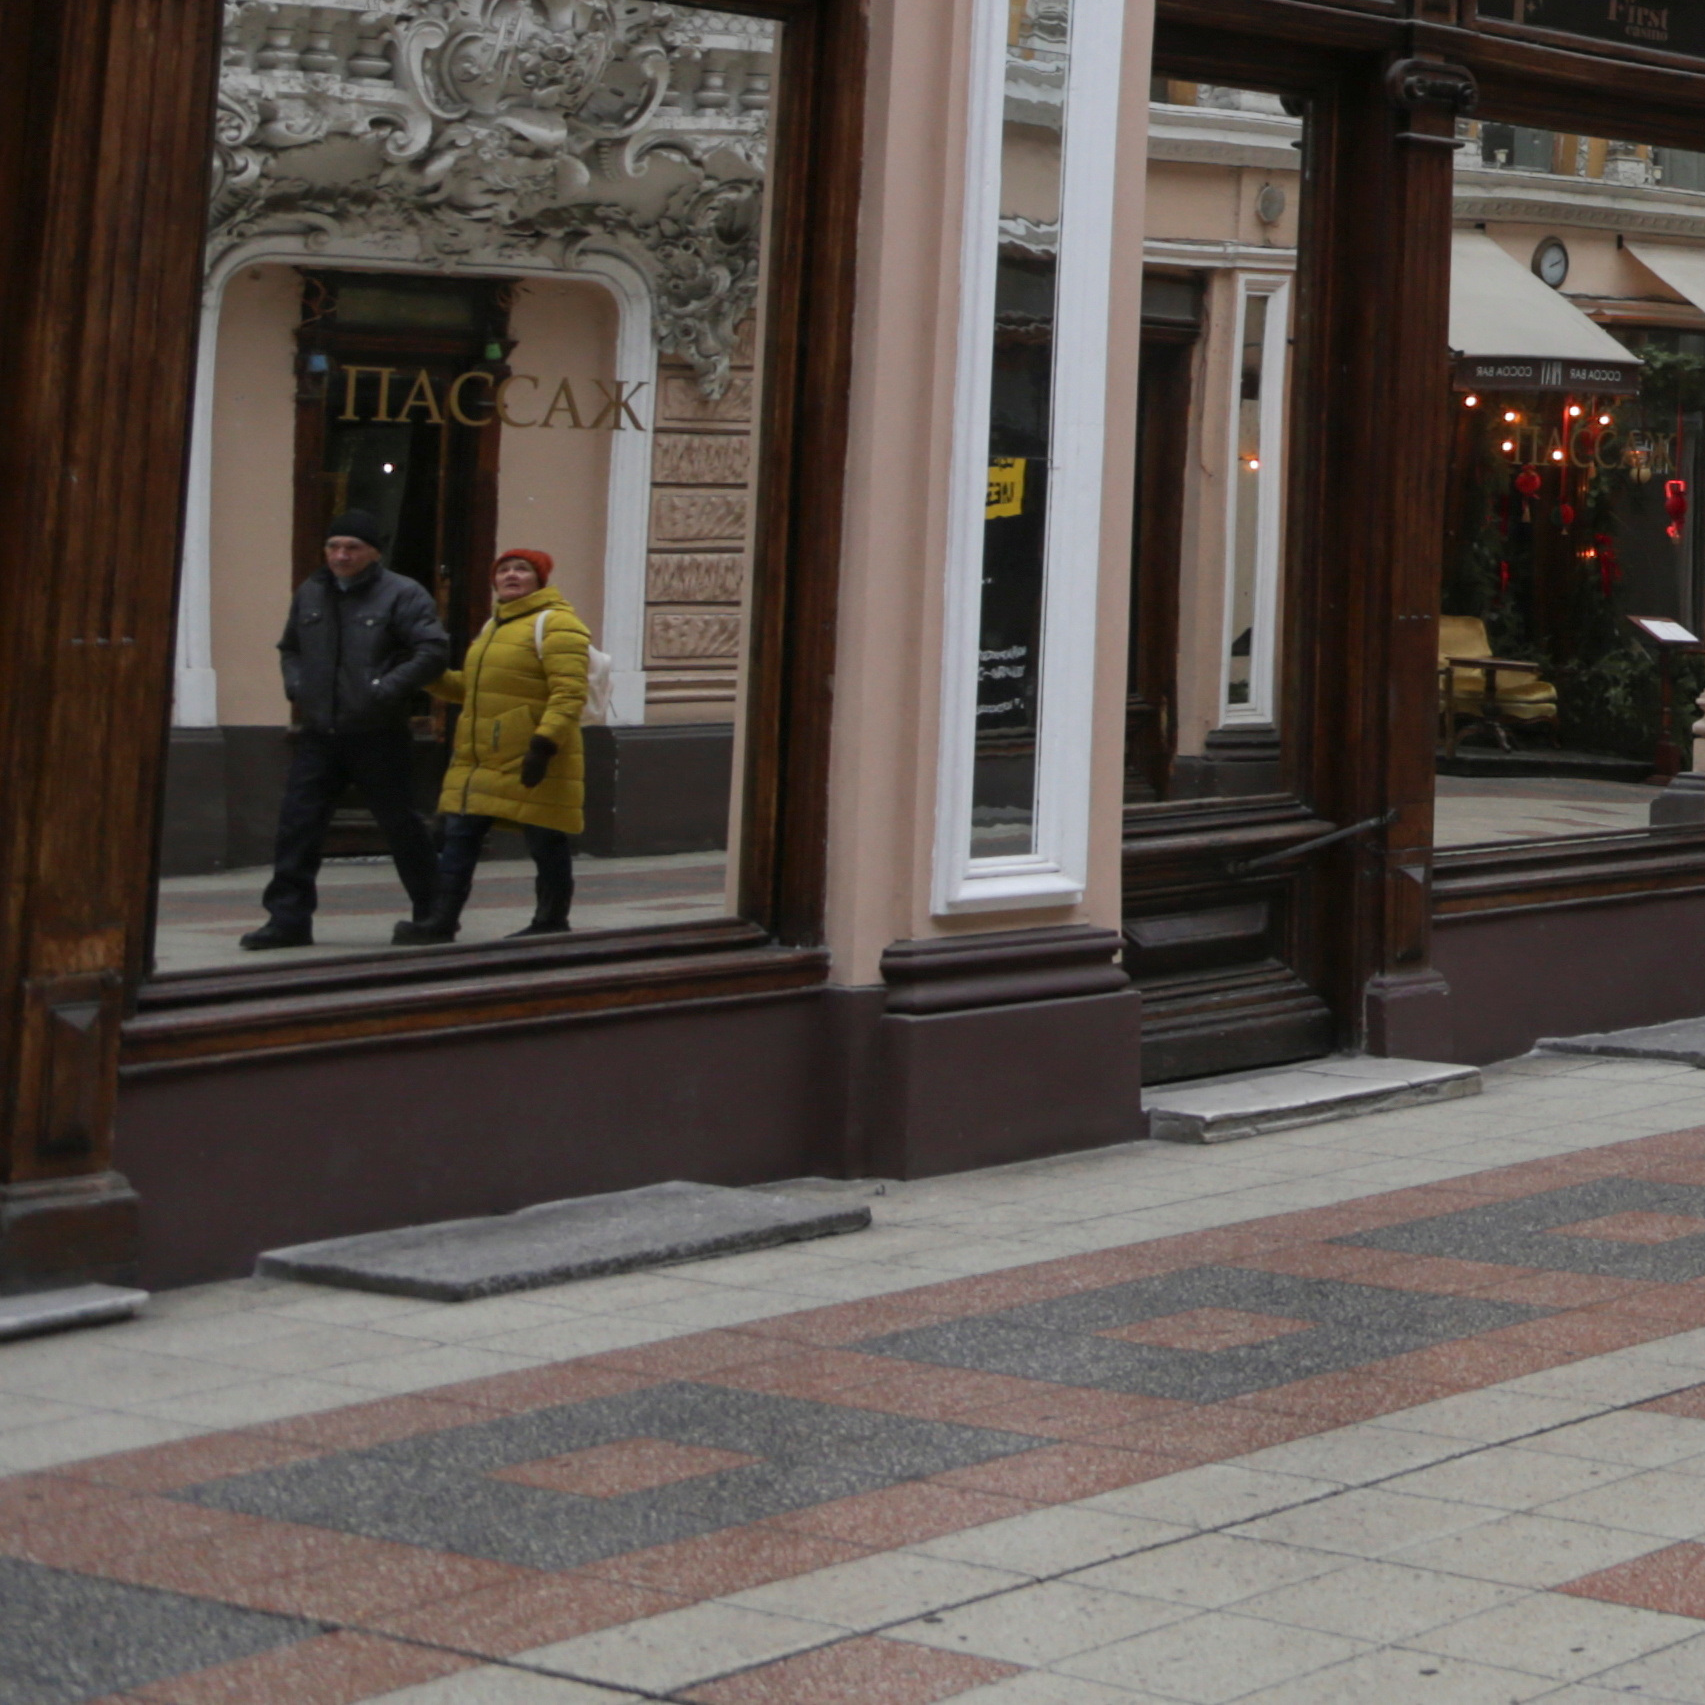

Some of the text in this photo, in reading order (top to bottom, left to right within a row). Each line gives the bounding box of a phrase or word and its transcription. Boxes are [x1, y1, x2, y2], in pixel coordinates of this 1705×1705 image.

[1624, 25, 1668, 42] casino
[339, 364, 649, 432] ПАССАЖ
[1511, 426, 1678, 471] ПАССАЖ
